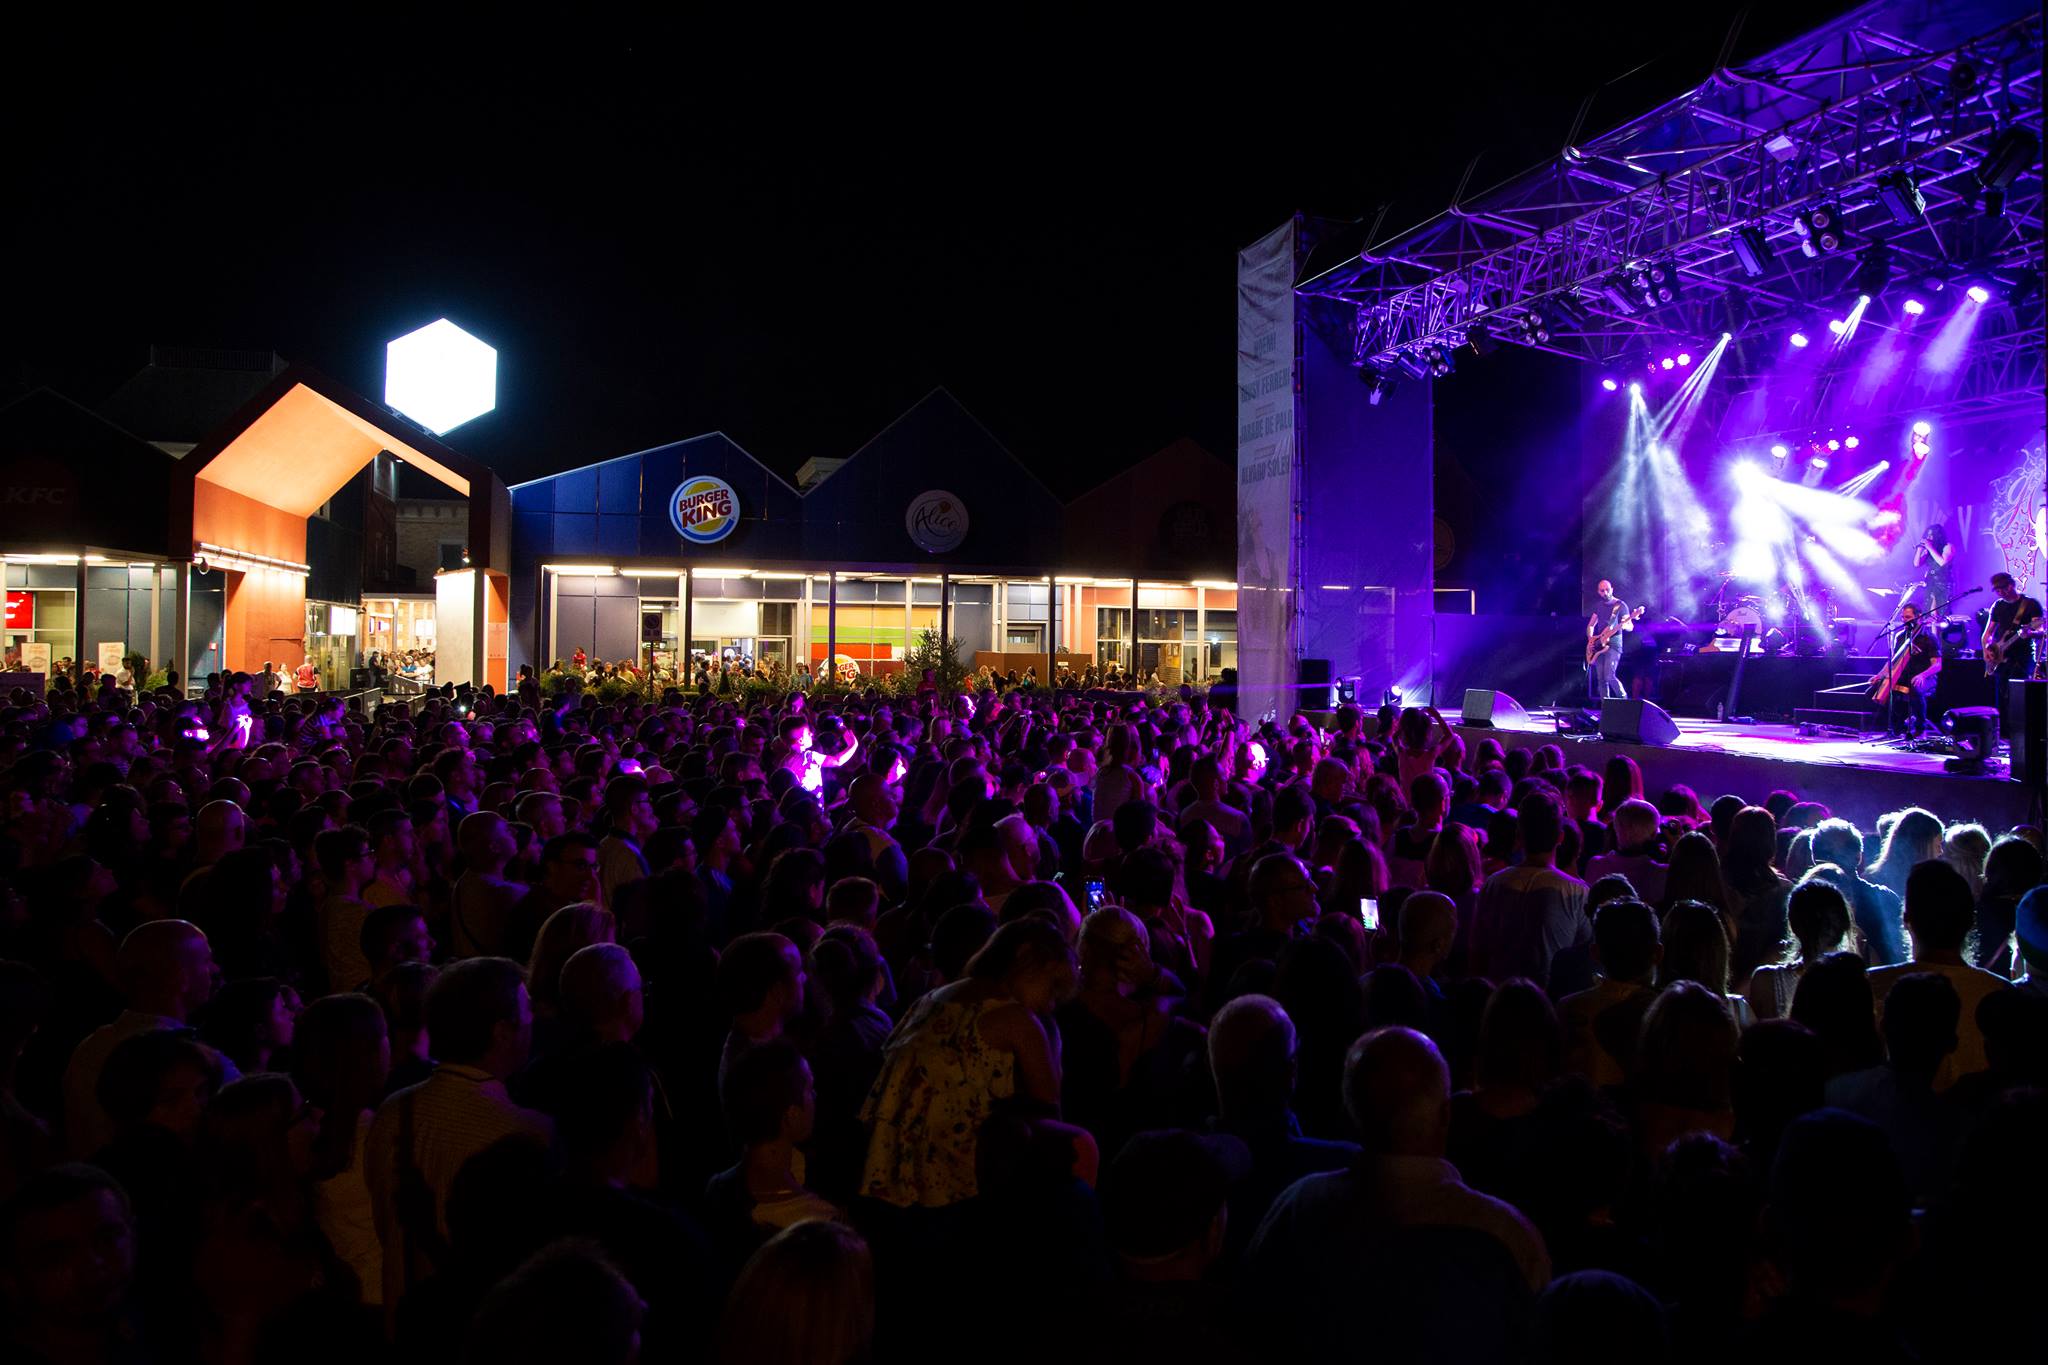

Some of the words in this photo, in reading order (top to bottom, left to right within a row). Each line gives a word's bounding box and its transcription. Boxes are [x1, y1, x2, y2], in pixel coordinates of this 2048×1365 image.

[8, 487, 65, 504] KFC
[679, 489, 729, 512] BURGER
[682, 500, 732, 528] KING
